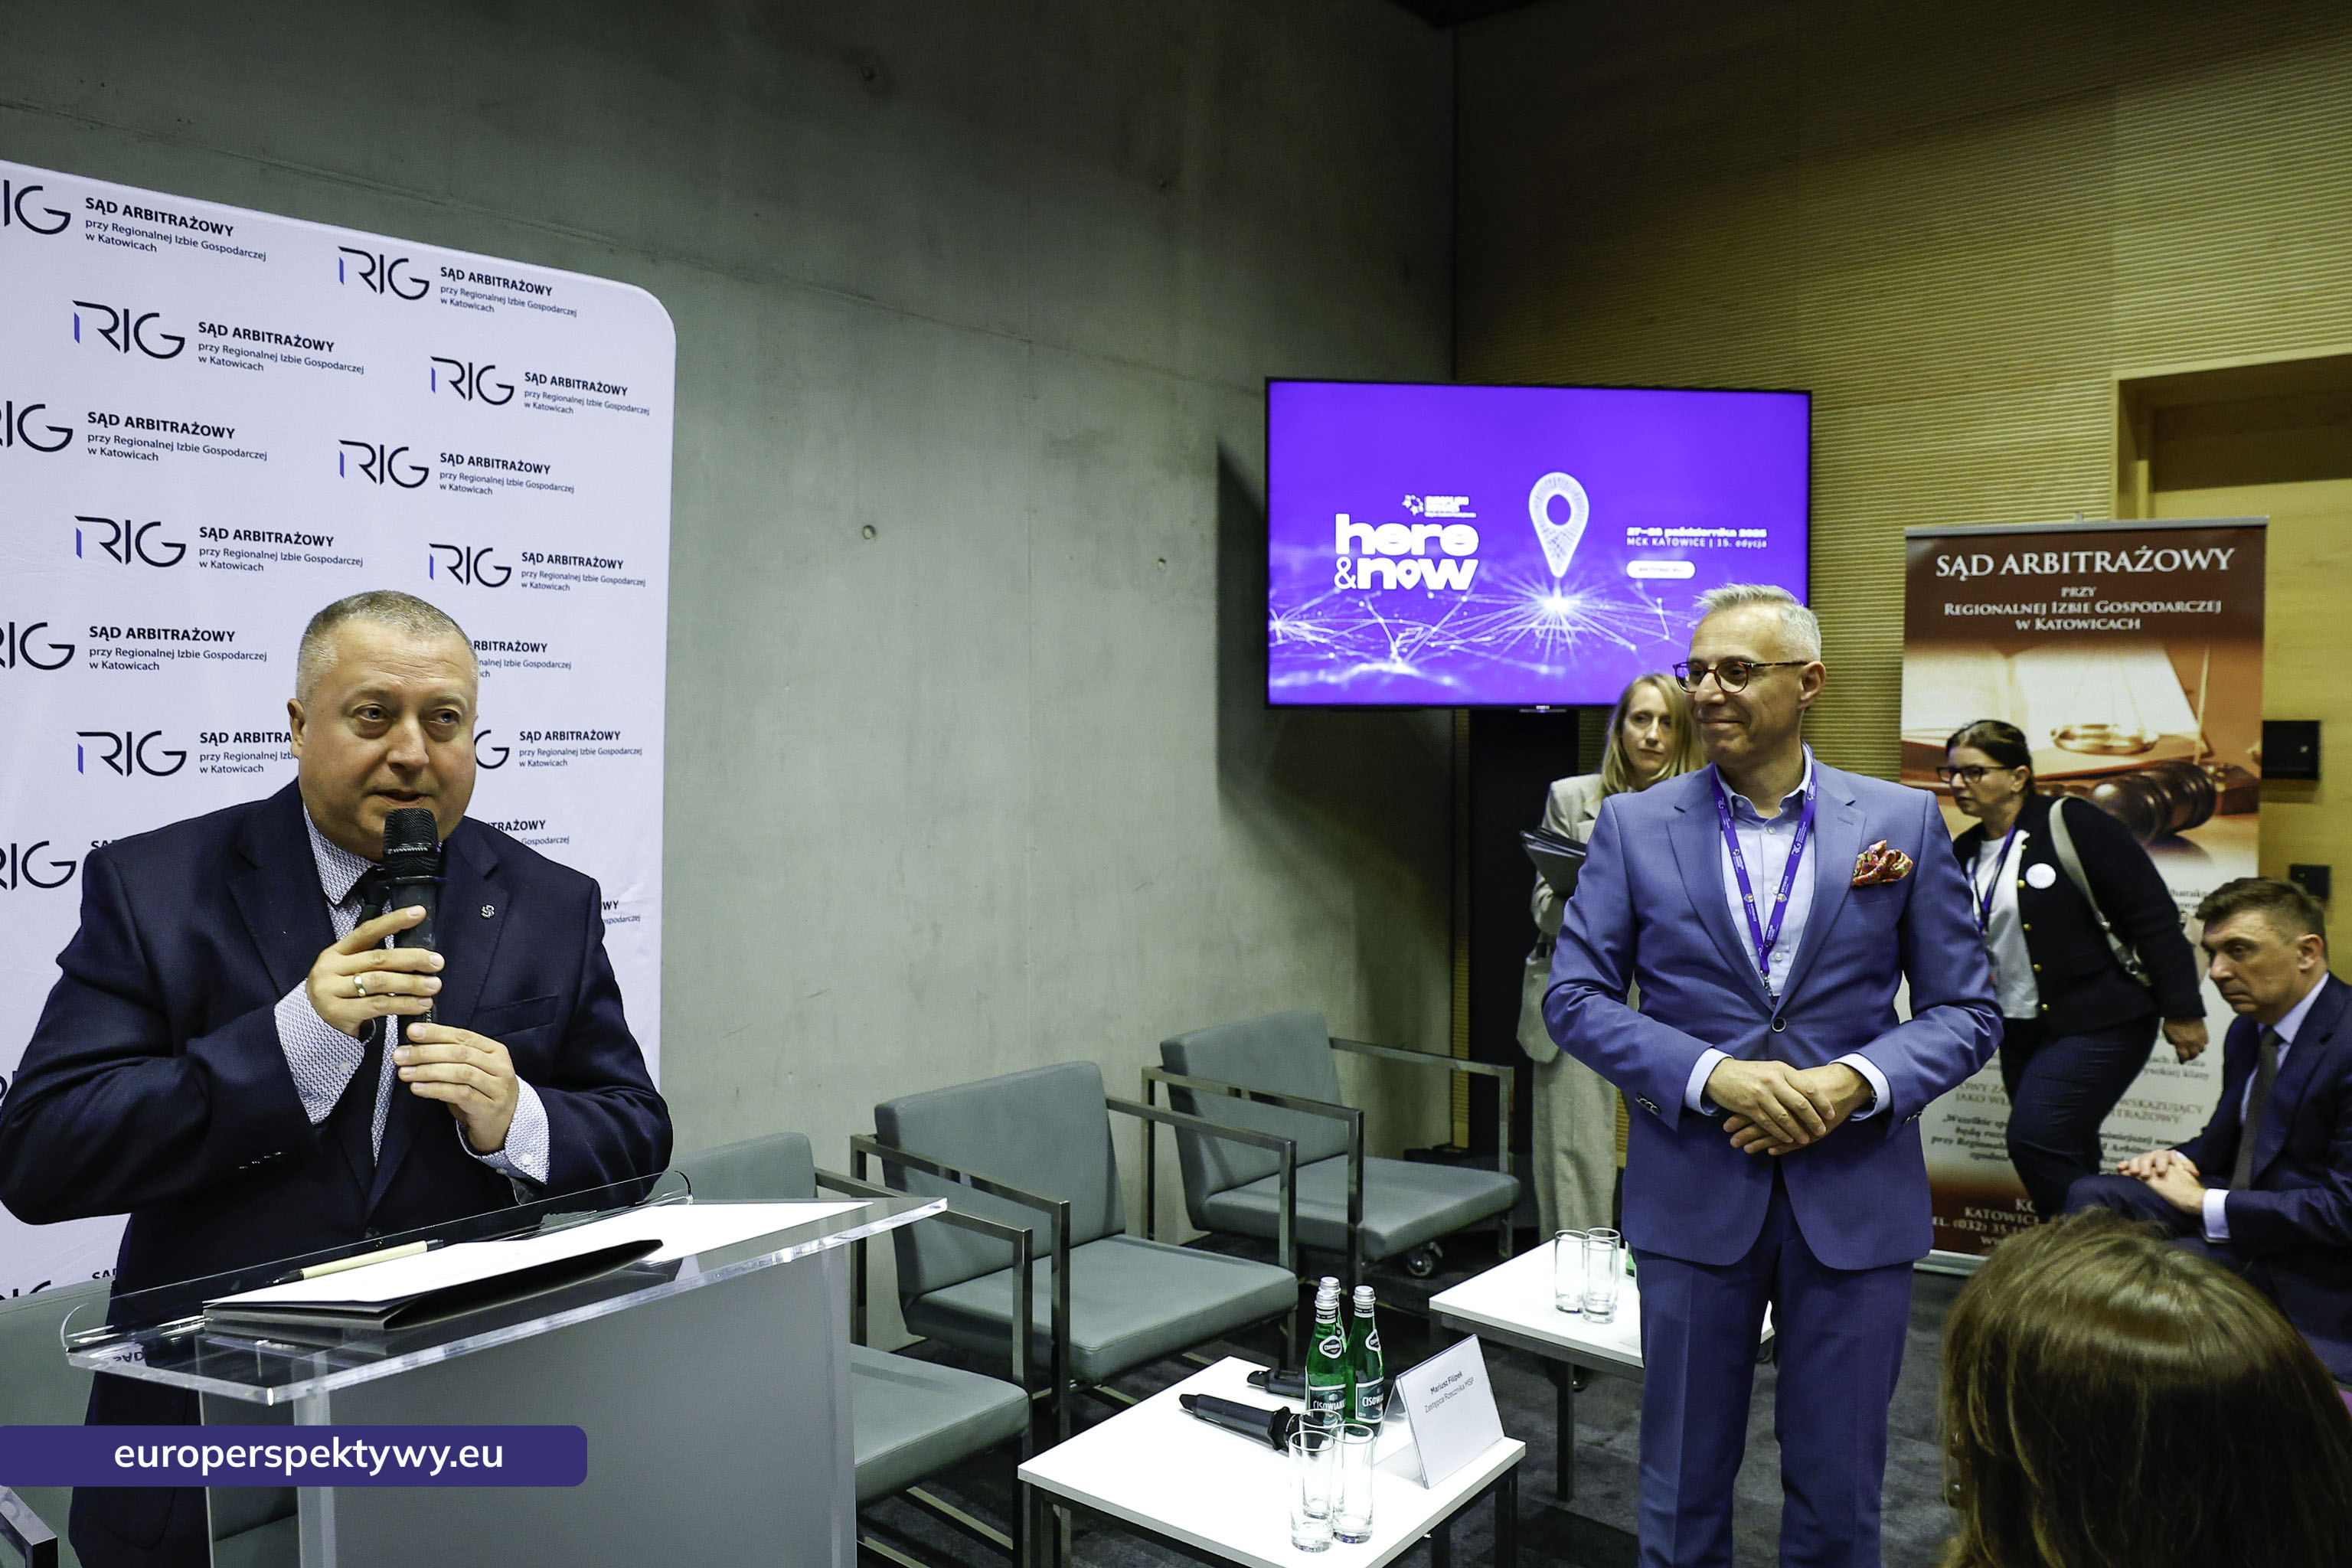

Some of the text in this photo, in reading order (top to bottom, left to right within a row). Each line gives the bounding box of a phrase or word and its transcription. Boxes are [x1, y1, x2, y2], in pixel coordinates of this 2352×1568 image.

[4, 179, 71, 235] IG
[85, 197, 234, 237] SĄD ARBITRAŻOWY
[85, 220, 266, 261] przy Regionalnej Izbie Gospodarczej
[85, 233, 157, 253] w Katowicach
[338, 246, 430, 301] RIG
[440, 266, 553, 296] SĄD ARBITRAŻOWY
[440, 286, 577, 318] przy Regionalnej Izbie Gospodarczej
[449, 298, 495, 312] Katowicach
[73, 300, 186, 360] RIG
[198, 322, 335, 353] SĄD ARBITRAŻOWY
[198, 343, 364, 375] przy Regionalnej Izbie Gospodarczej
[210, 355, 264, 371] Katowicach
[430, 356, 514, 406] RIG
[524, 371, 628, 397] SĄD ARBITRAŻOWY
[524, 390, 649, 416] przy Regionalnej Izbie Gospodarczej
[533, 402, 573, 414] Katowicach
[0, 400, 74, 452] IG
[87, 411, 235, 439] SĄD ARBITRAŻOWY
[87, 434, 267, 462] przy Regionalnej Izbie Gospodarczej
[100, 446, 158, 461] Katowicach
[338, 439, 430, 488] RIG
[440, 452, 550, 475] SĄD ARBITRAŻOWY
[439, 472, 574, 495] przy Regionalnej Izbie Gospodarczej
[449, 483, 493, 495] Katowicach
[74, 515, 186, 567] RIG
[199, 526, 335, 547] SĄD ARBITRAŻOWY
[1335, 513, 1480, 557] here
[1651, 537, 1706, 547] KATOWICE
[199, 547, 363, 567] przy Regionalnej Izbie Gospodarczej
[211, 560, 264, 571] Katowicach
[429, 543, 512, 588] RIG
[521, 551, 624, 570] SĄD ARBITRAŻOWY
[1936, 545, 2236, 582] SĄD ARBITRAŻOWY
[521, 571, 537, 580] przy
[539, 570, 581, 583] Regionalnej
[600, 575, 645, 588] Gospodarczej
[529, 581, 570, 591] Katowicach
[2060, 586, 2097, 598] PRZY
[89, 626, 236, 642] SĄD ARBITRAŻOWY
[0, 621, 75, 671] IG
[89, 647, 267, 662] przy Regionalnej Izbie Gospodarczej
[473, 640, 548, 653] RBITRAŻOWY
[101, 660, 160, 671] Katowicach
[479, 658, 572, 670] nalnej Izbie Gospodarczej
[200, 732, 292, 746] SĄD ARBITRA
[519, 729, 621, 744] SĄD ARBITRAŻOWY
[77, 730, 188, 777] RIG
[200, 753, 220, 763] przy
[224, 751, 278, 763] Regionalnej
[528, 759, 568, 767] Katowicach
[537, 748, 578, 757] Regionalnej
[580, 747, 596, 756] Izbie
[598, 747, 642, 756] Gospodarczej
[211, 763, 264, 773] Katowicach
[0, 841, 77, 890] IG
